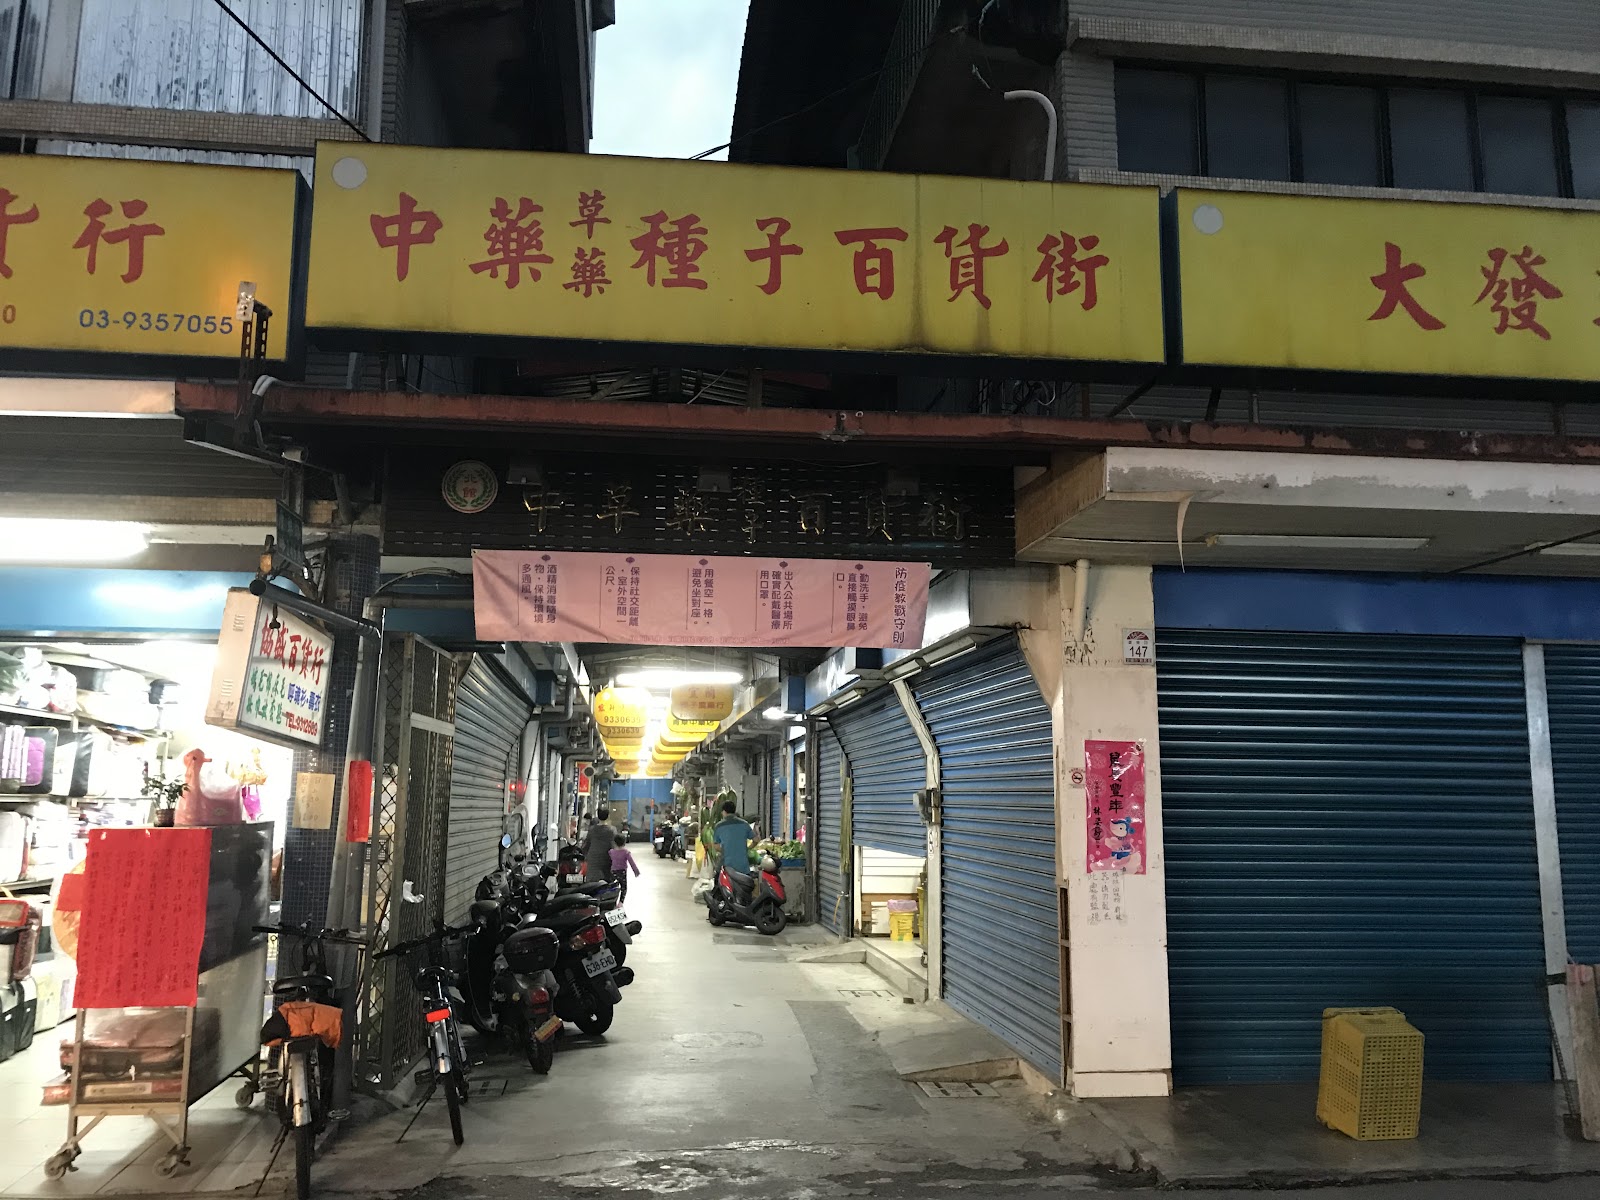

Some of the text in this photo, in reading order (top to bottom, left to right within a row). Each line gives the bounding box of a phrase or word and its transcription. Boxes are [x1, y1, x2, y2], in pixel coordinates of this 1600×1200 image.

[1366, 242, 1600, 341] 大發
[79, 308, 234, 336] 03-9357055
[546, 564, 558, 624] 酒精消毒隨身
[629, 566, 641, 627] 保持社交距離
[771, 570, 782, 630] 確實配戴醫療
[782, 571, 794, 630] 出入公共場所
[846, 573, 858, 631] 直接觸摸眼鼻
[893, 567, 908, 644] 防疫教戰守則
[1129, 645, 1148, 658] 147
